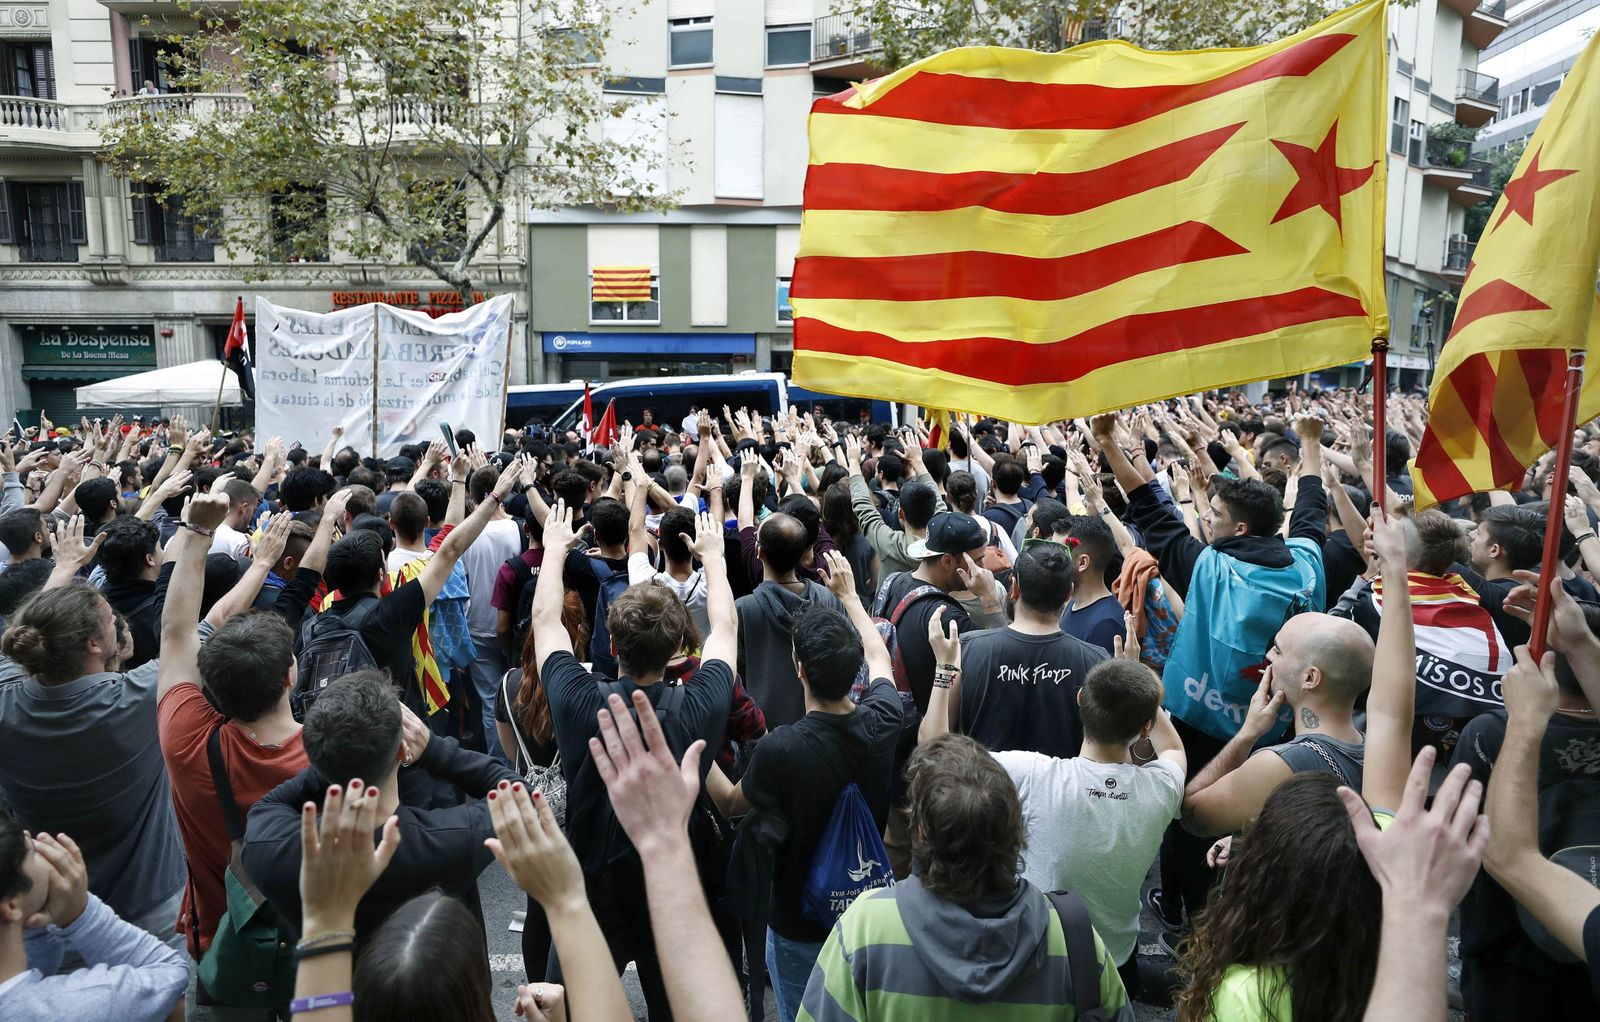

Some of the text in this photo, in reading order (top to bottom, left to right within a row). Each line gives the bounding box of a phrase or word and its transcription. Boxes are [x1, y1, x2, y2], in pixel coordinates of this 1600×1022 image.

[331, 291, 487, 305] RESTAURANTE PIZZEIA
[40, 329, 151, 350] La Despensa
[60, 350, 129, 360] De La Buena Mesa
[997, 662, 1072, 685] PINK FLOYD
